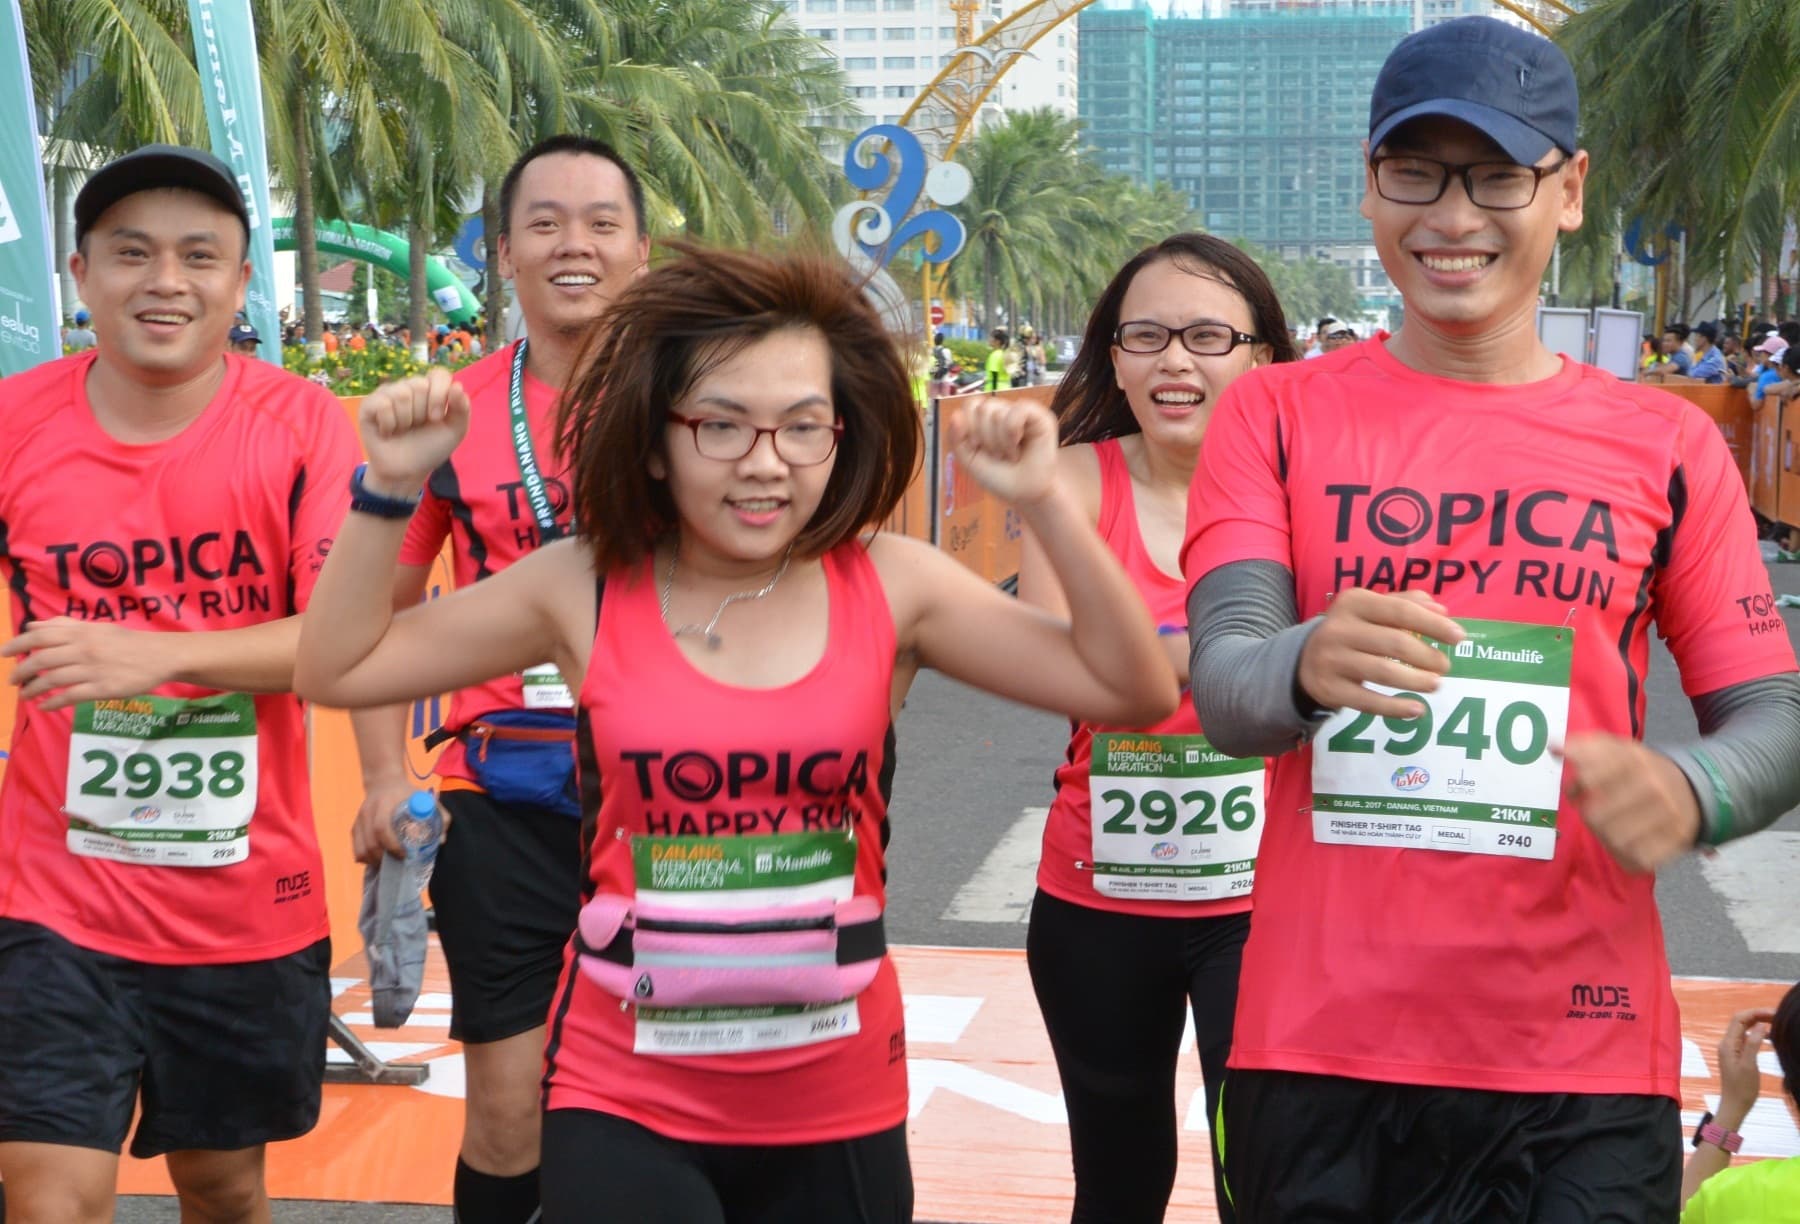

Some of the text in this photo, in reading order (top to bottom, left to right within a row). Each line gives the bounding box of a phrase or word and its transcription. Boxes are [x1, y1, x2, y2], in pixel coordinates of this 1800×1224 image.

[1325, 484, 1620, 563] TOPICA
[46, 530, 264, 589] TOPICA
[1335, 556, 1615, 610] HAPPY RUN
[64, 585, 270, 621] HAPPY RUN
[1736, 593, 1774, 618] TOP
[1475, 645, 1544, 664] Manulife
[1328, 692, 1549, 766] 2940
[1108, 738, 1162, 752] DANANG
[1107, 762, 1163, 773] MARATHON
[1108, 751, 1177, 765] INTERNATIONAL
[80, 749, 245, 799] 2938
[620, 751, 868, 802] TOPICA
[1447, 768, 1475, 788] pulse
[1101, 785, 1257, 836] 2926
[1423, 804, 1458, 814] VIETNAM
[1491, 808, 1531, 822] 21KM
[645, 807, 787, 837] HAPPY
[1330, 820, 1422, 832] FINISHER T-SHIRT TAG
[1438, 830, 1466, 840] MEDAL
[1498, 834, 1532, 848] 2940
[651, 844, 723, 861] DANANG
[775, 849, 833, 872] Manulife
[1224, 861, 1251, 874] 21KM
[1231, 879, 1253, 890] 2926
